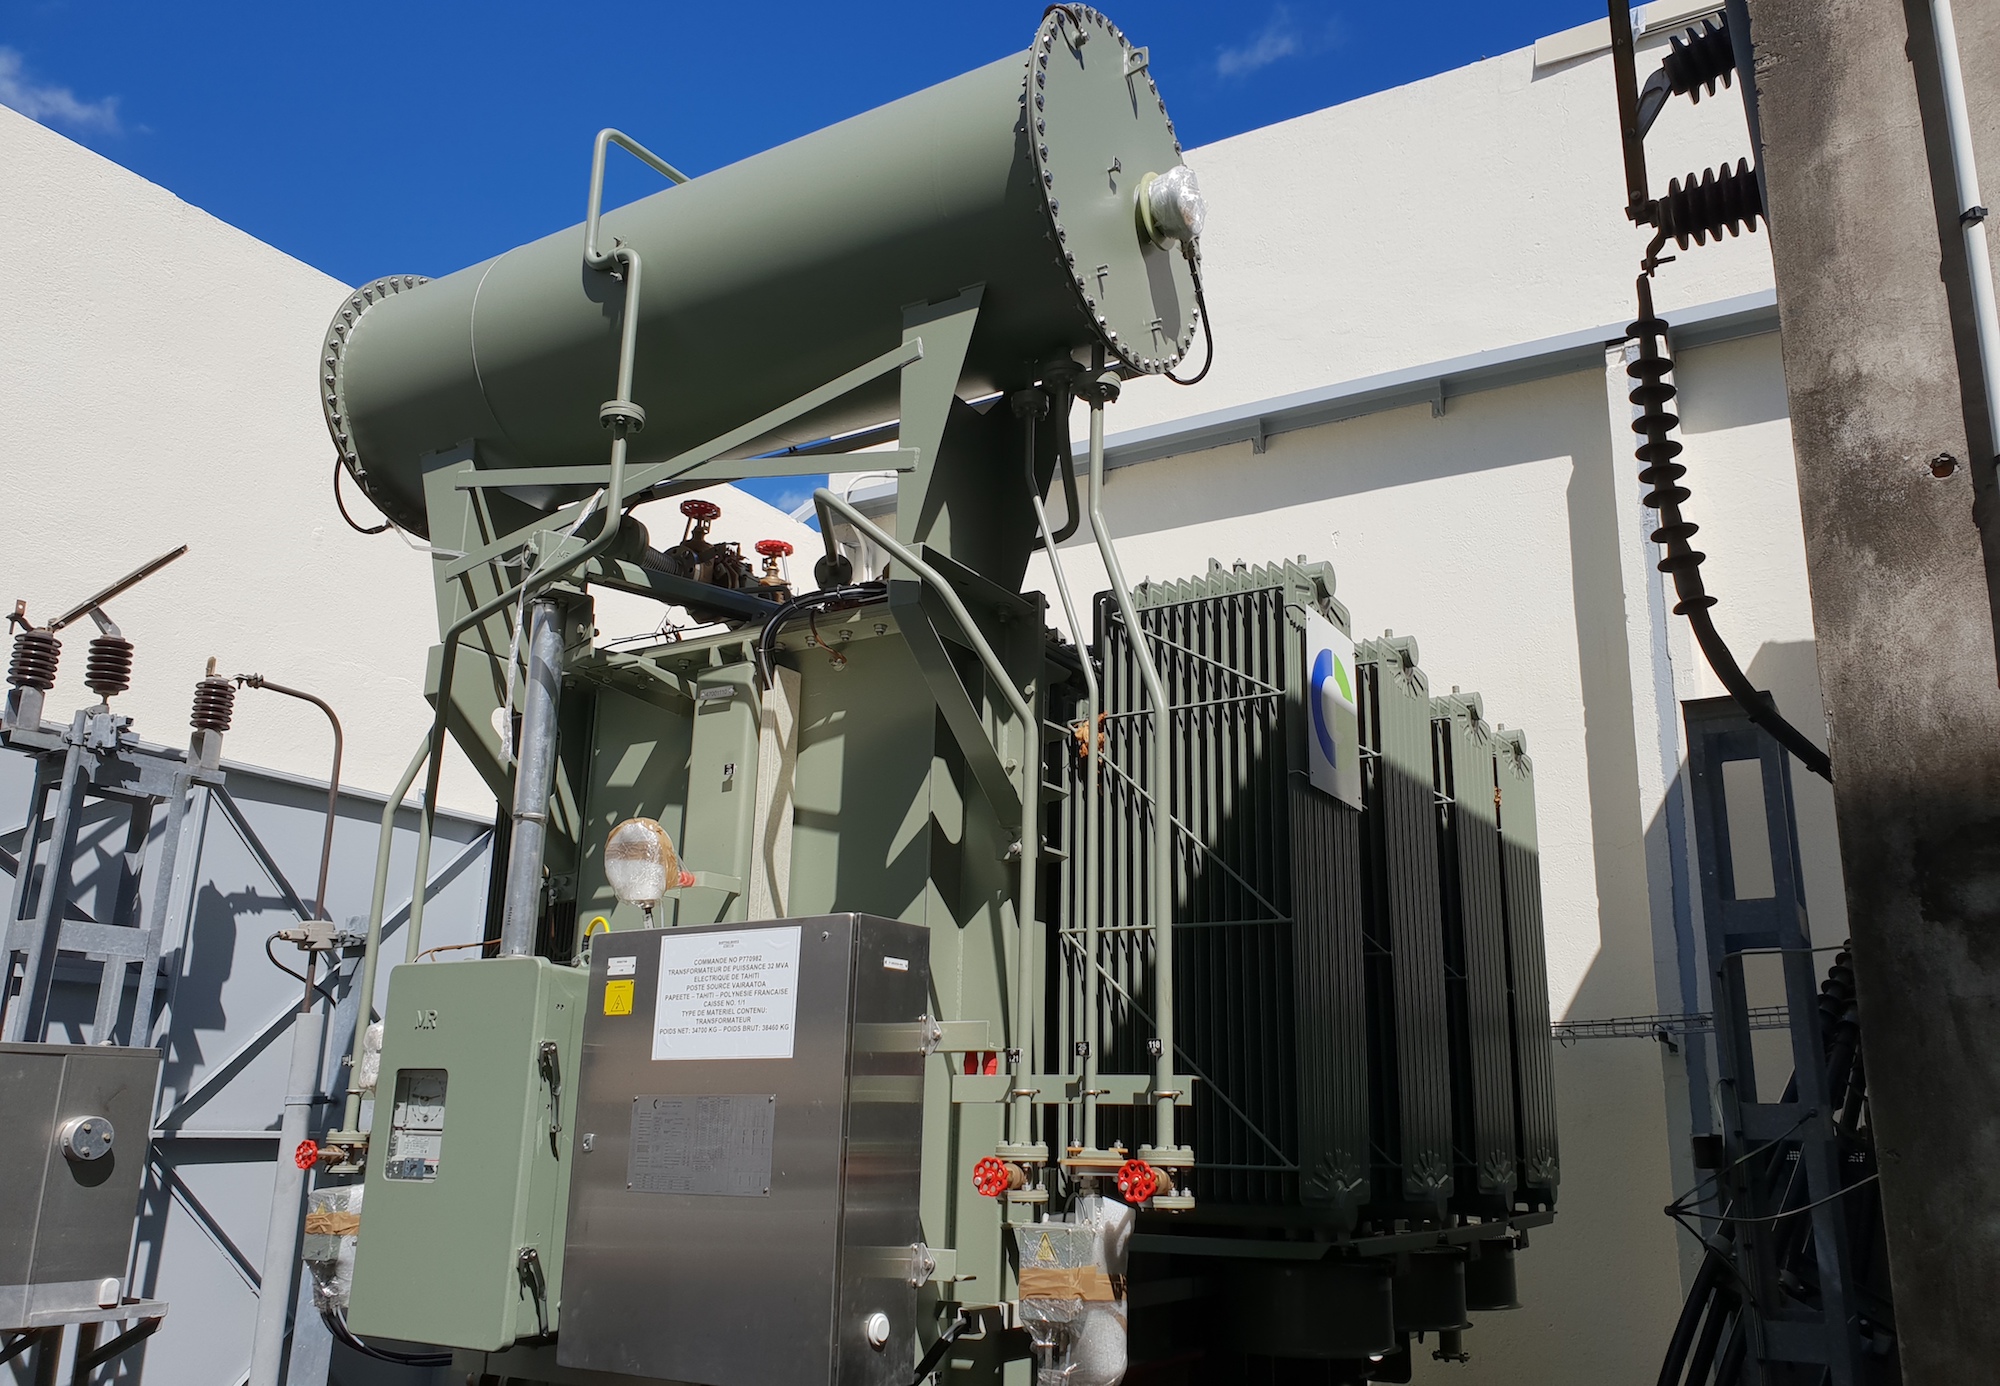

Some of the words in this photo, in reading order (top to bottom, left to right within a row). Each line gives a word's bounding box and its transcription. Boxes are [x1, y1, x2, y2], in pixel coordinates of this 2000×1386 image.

[694, 957, 727, 965] COMMANDE
[669, 966, 721, 975] TRANSFORMATEUR
[414, 1009, 438, 1030] MR
[1149, 1040, 1160, 1048] 118
